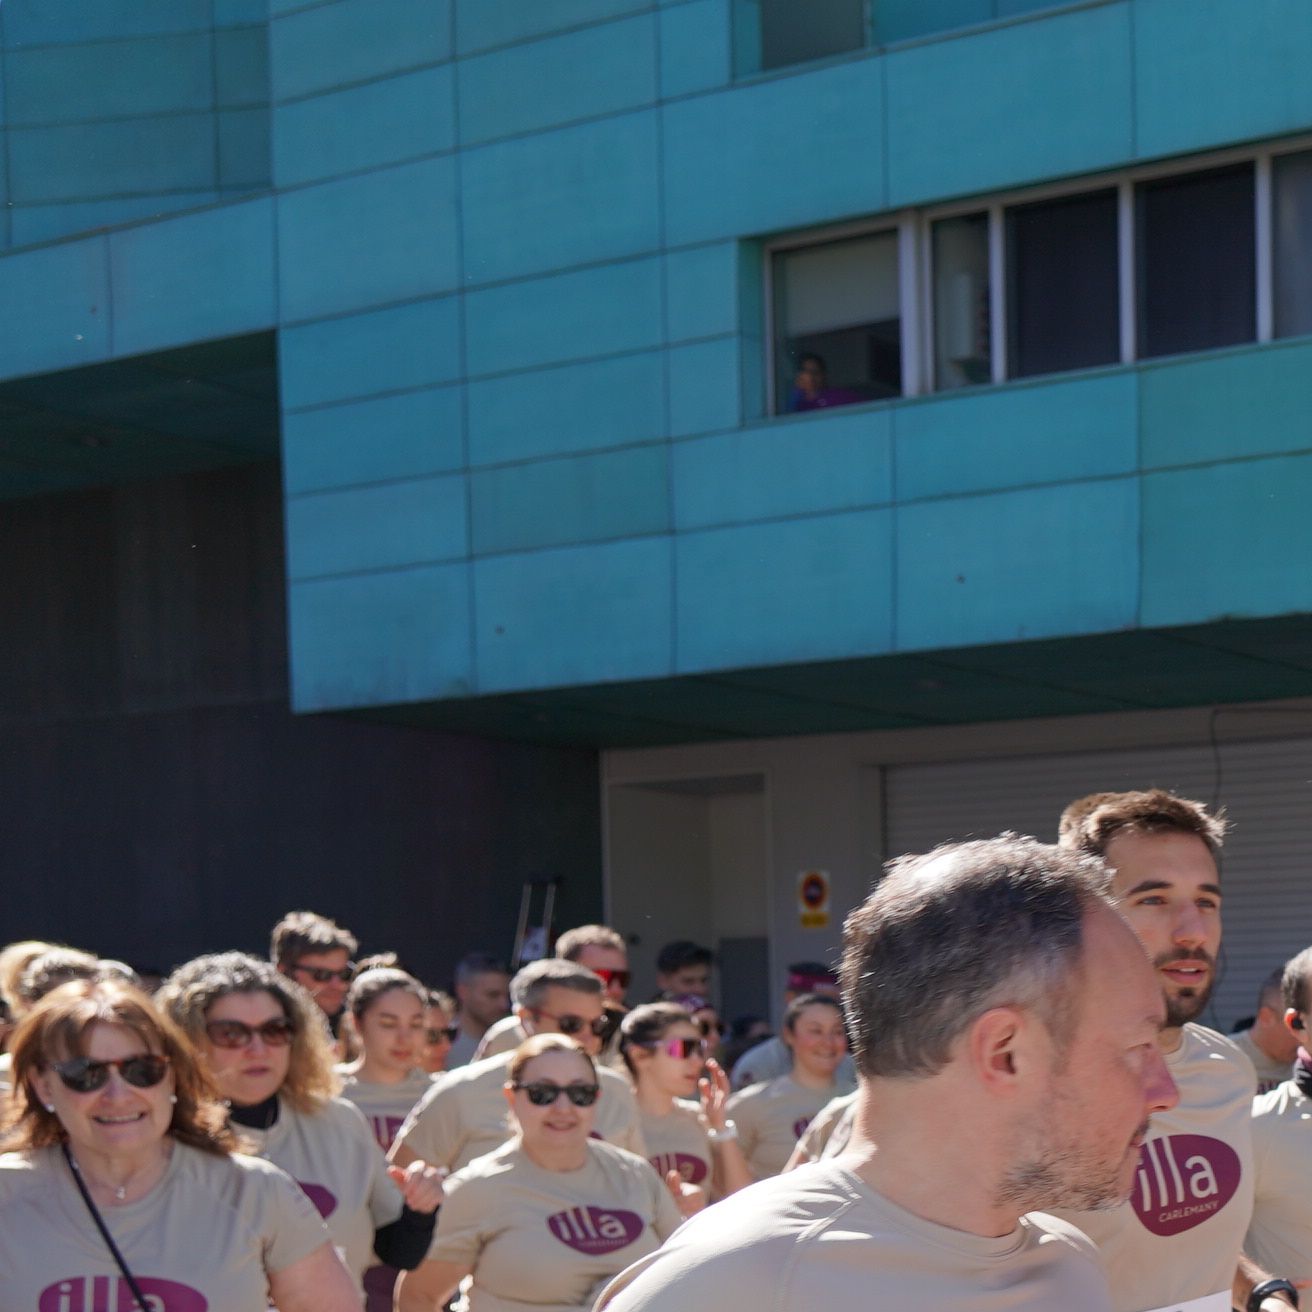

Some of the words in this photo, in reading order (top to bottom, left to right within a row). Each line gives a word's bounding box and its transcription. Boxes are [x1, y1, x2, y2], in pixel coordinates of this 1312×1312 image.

[1138, 1136, 1218, 1212] illa
[552, 1206, 627, 1241] illa
[1159, 1200, 1219, 1222] CARLEMANY
